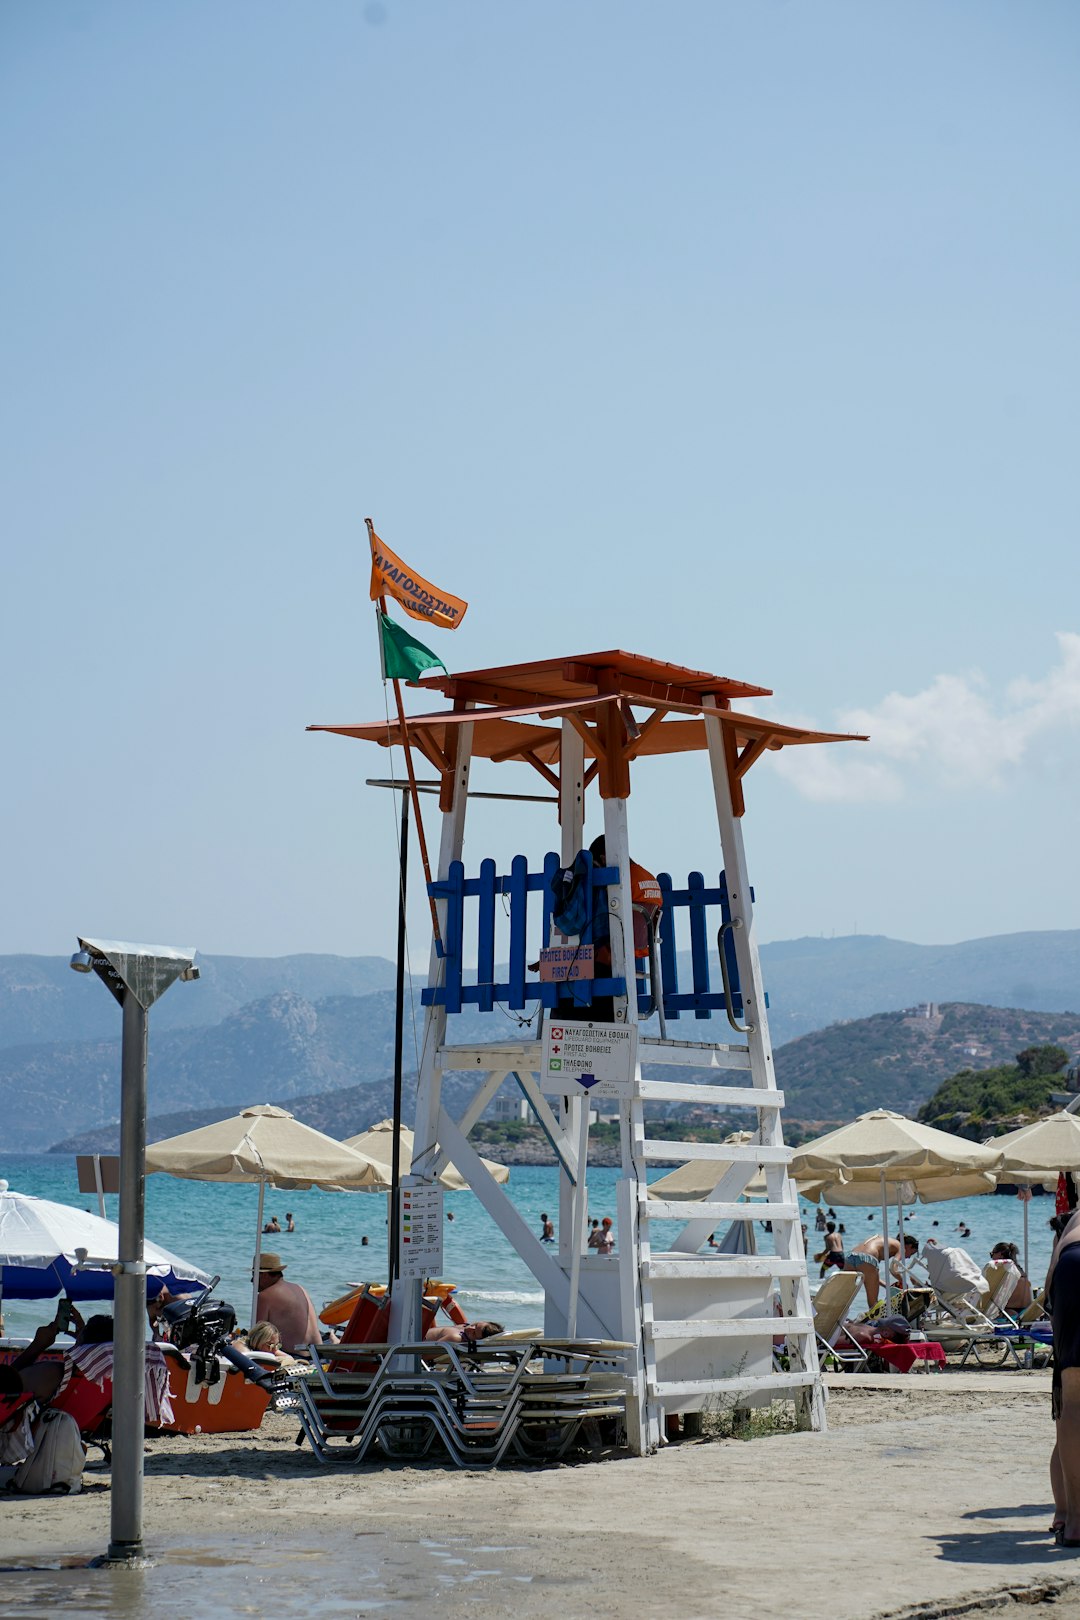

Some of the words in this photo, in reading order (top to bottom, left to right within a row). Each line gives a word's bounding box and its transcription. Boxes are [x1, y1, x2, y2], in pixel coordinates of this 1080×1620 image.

[374, 551, 459, 618] ΑΥΑΓΟΣΩΣΤΗΣ
[552, 966, 567, 978] FIRST
[564, 1029, 607, 1038] ΝΑΥΑΓΟΣΩΣΤΙΚΑ
[608, 1031, 630, 1040] ΕΦΟΔΙΑ
[564, 1044, 584, 1052] ΠΡΩΤΕΣ
[586, 1045, 612, 1054] ΒΟΗΘΕΙΕΣ
[564, 1060, 593, 1068] ΤΗΛΕΦΩΝΟ
